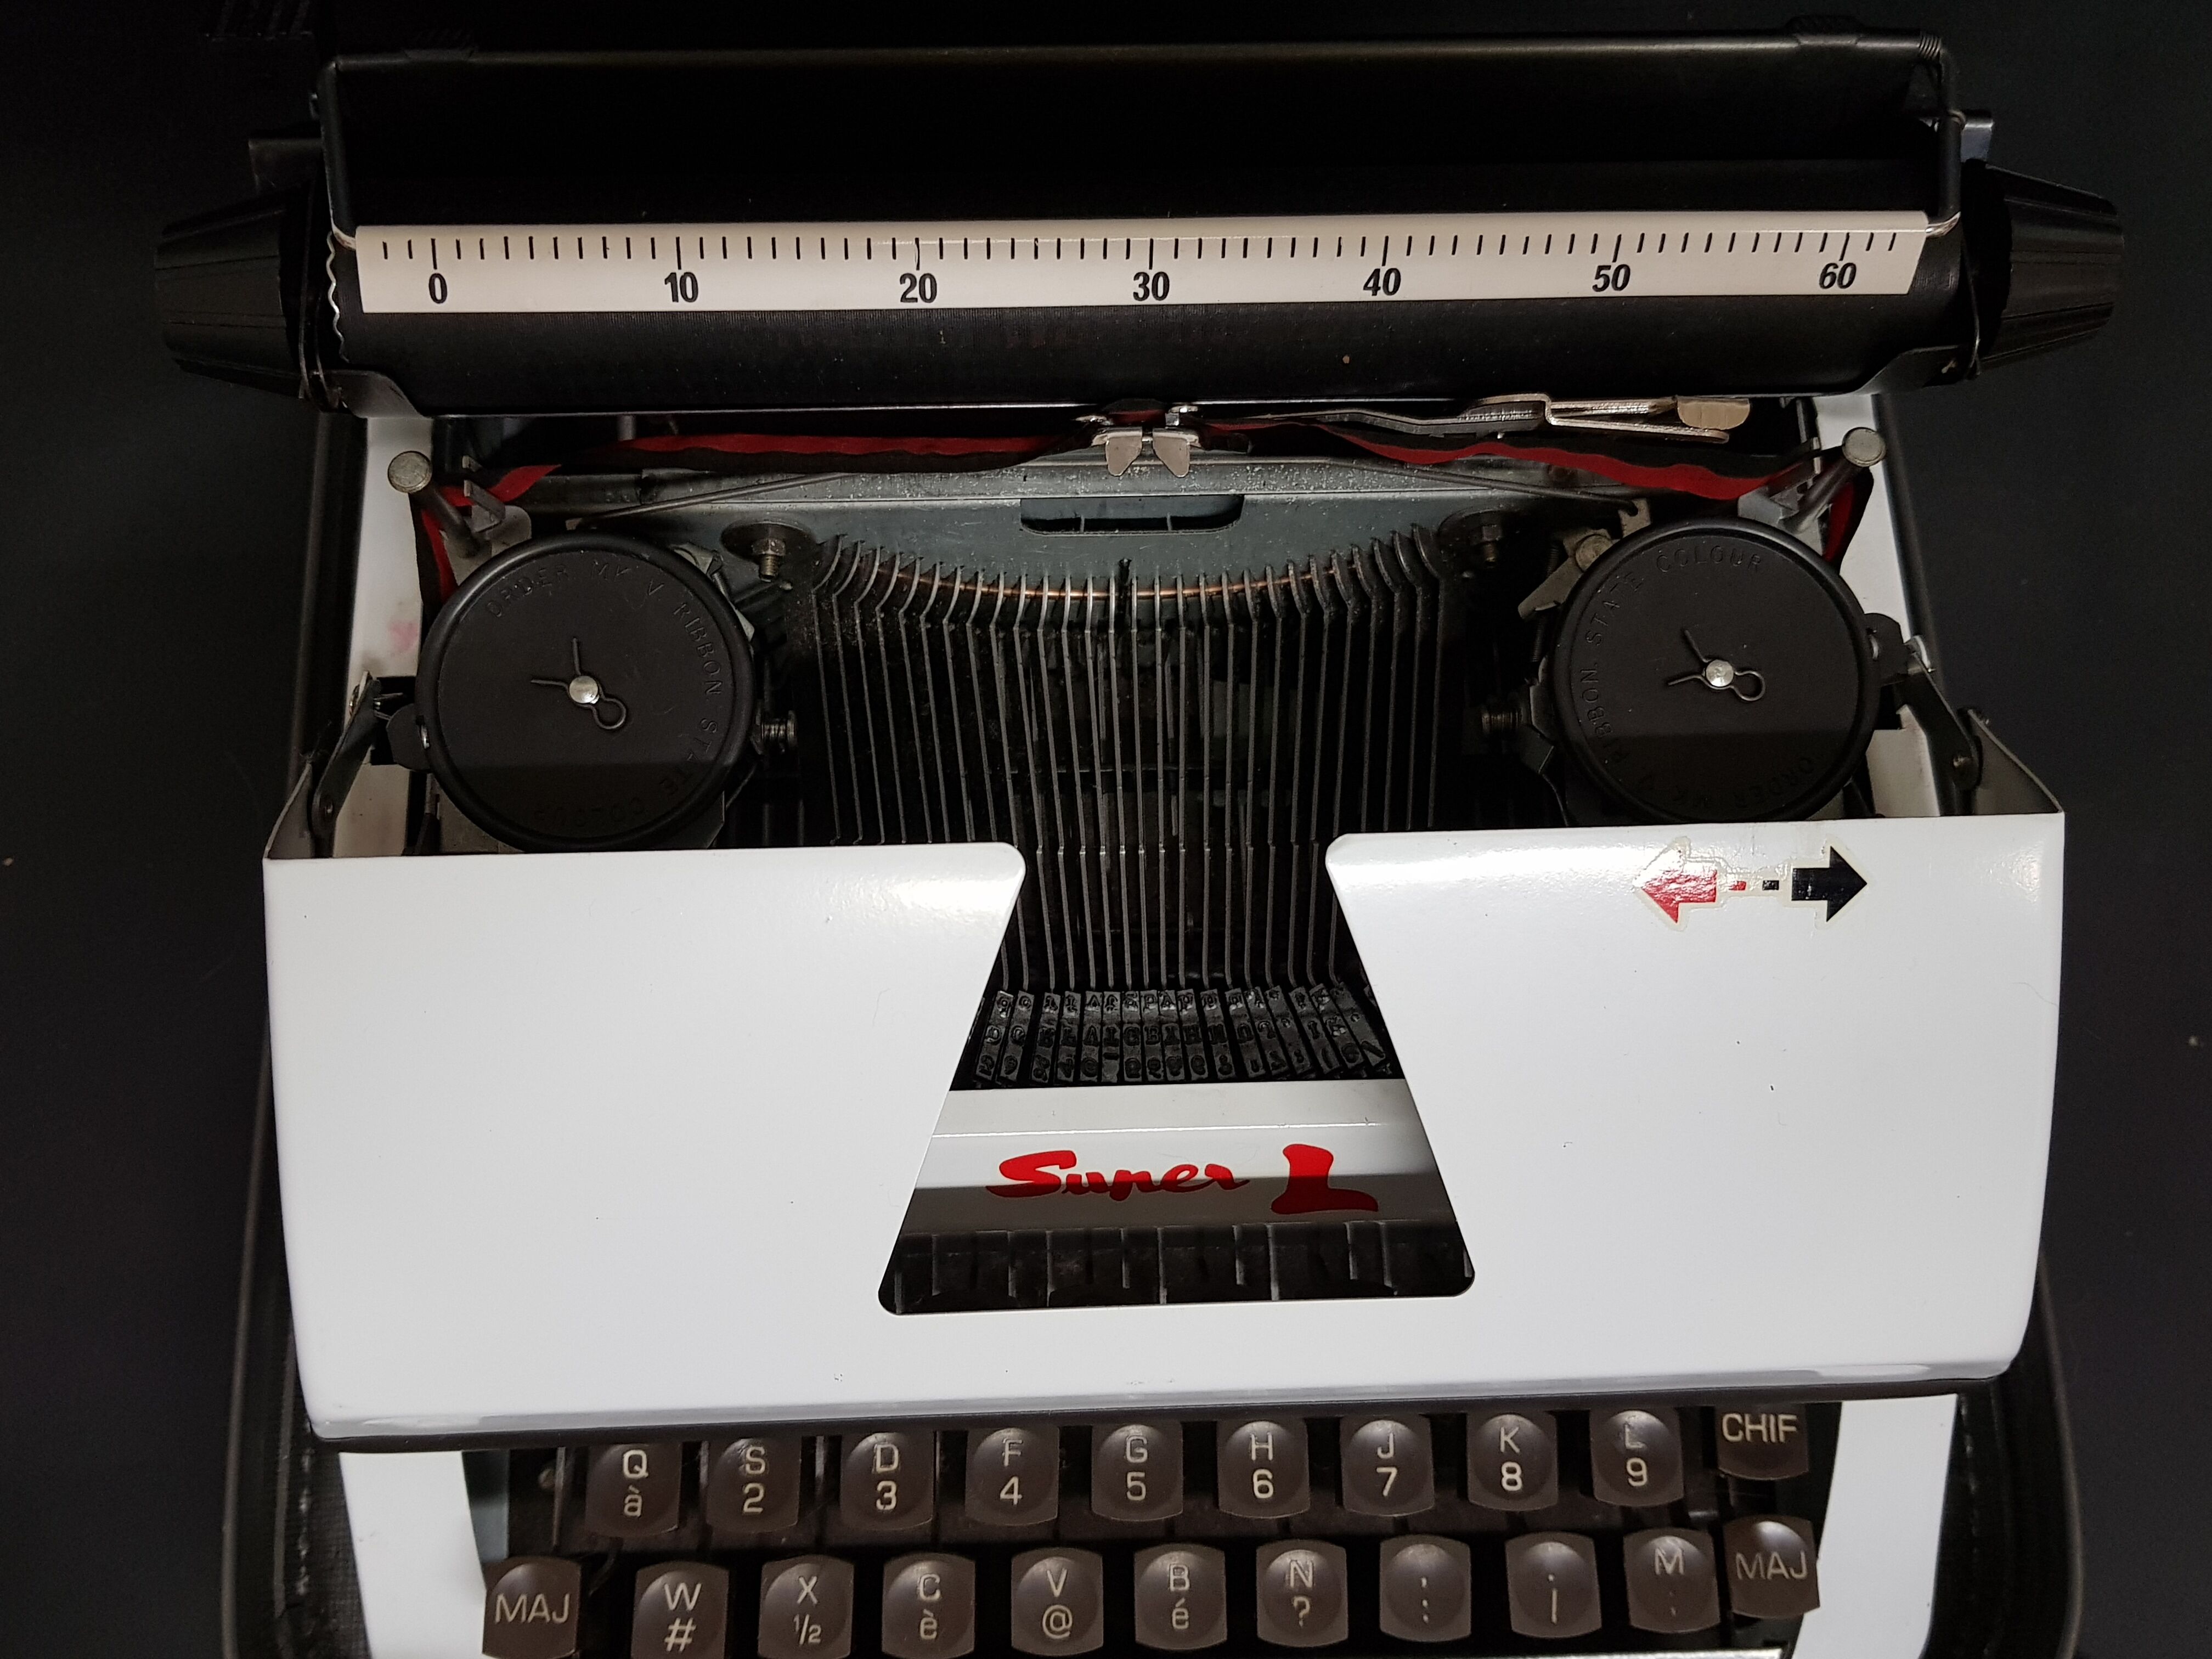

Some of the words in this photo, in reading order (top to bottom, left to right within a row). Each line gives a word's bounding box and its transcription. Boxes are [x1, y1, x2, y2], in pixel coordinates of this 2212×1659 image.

[428, 273, 447, 303] 0
[665, 272, 698, 302] 10
[900, 273, 936, 303] 20
[1133, 272, 1169, 301] 30
[1363, 268, 1401, 296] 40
[1593, 264, 1630, 292] 50
[1819, 263, 1857, 289] 60
[1656, 545, 1761, 572] COLOUR
[985, 1150, 1250, 1201] Super
[1271, 1144, 1379, 1215] L
[1500, 1427, 1520, 1453] K
[1624, 1422, 1645, 1449] L
[1723, 1413, 1796, 1442] CHIF
[744, 1445, 766, 1474] S
[874, 1443, 899, 1474] D
[1001, 1437, 1022, 1467] F
[1125, 1435, 1148, 1463] G
[1250, 1432, 1273, 1461] H
[1376, 1431, 1395, 1459] J
[624, 1450, 648, 1478] Q
[1502, 1462, 1522, 1491] 8
[1627, 1458, 1647, 1486] 9
[877, 1481, 896, 1510] 3
[1000, 1477, 1022, 1504] 4
[1127, 1472, 1146, 1500] 5
[1253, 1469, 1273, 1498] 6
[1377, 1468, 1397, 1496] 7
[743, 1483, 764, 1512] 2
[1289, 1559, 1314, 1588] N
[1654, 1548, 1685, 1575] M
[1736, 1551, 1807, 1579] MAJ
[797, 1576, 817, 1604] X
[917, 1573, 940, 1601] C
[1046, 1567, 1067, 1598] V
[1169, 1564, 1190, 1592] B
[495, 1594, 569, 1623] MAJ
[665, 1583, 701, 1610] W
[1294, 1596, 1310, 1626] ?
[920, 1609, 937, 1639] è
[1042, 1605, 1072, 1639] @
[1172, 1598, 1188, 1629] é
[665, 1618, 696, 1651] #
